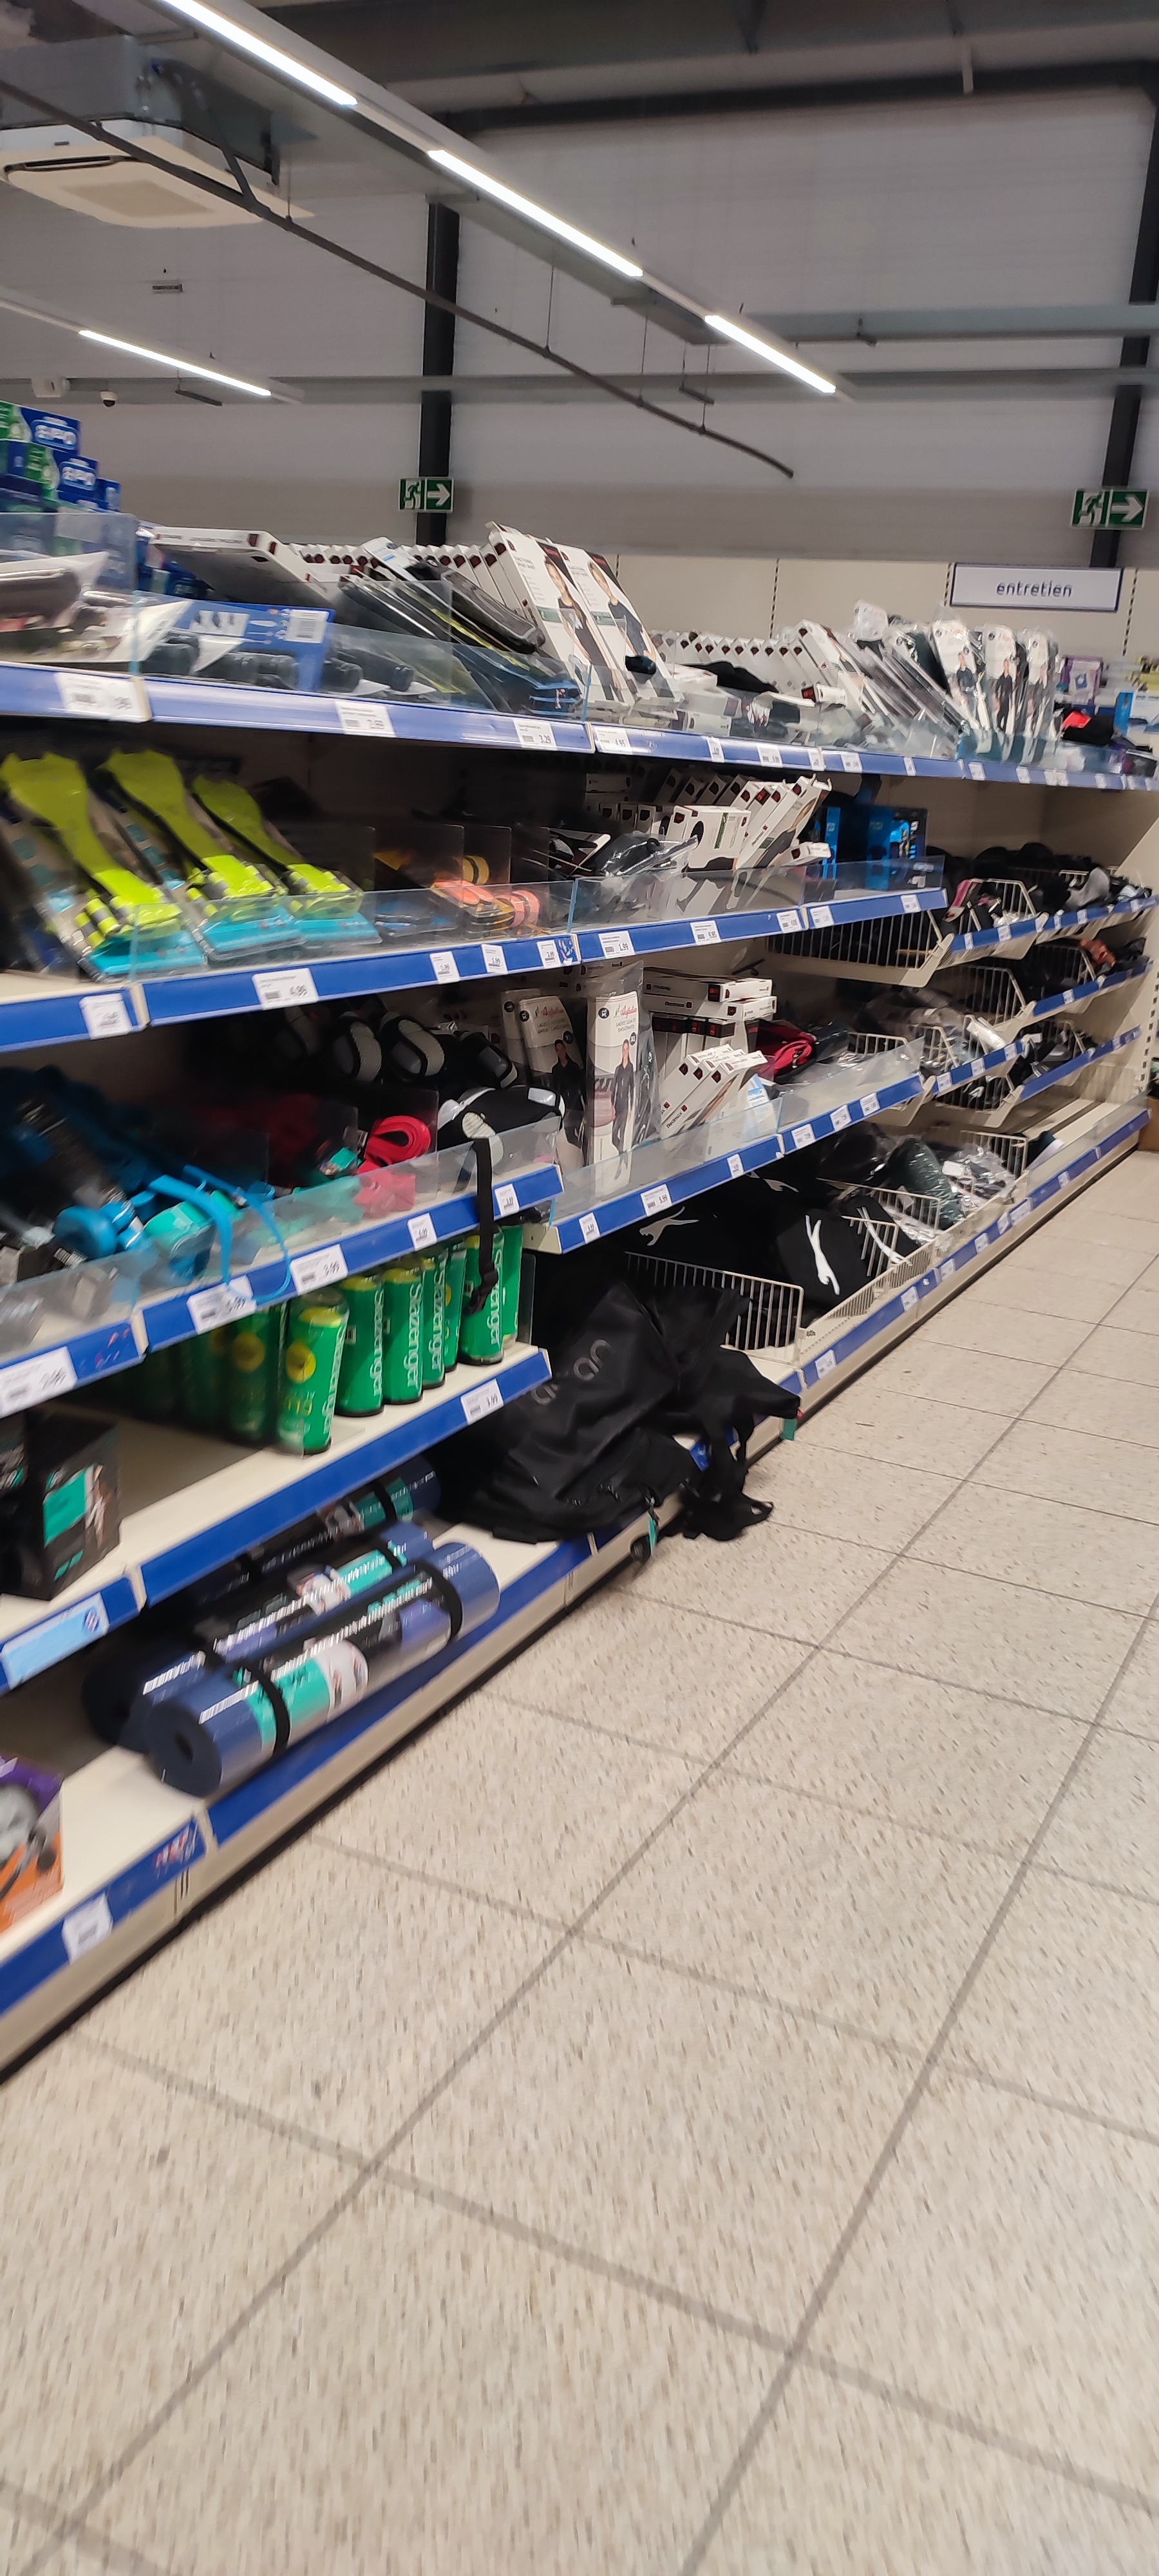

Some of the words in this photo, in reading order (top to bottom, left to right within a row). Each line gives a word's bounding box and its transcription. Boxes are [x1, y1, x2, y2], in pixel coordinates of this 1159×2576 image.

[996, 580, 1072, 598] entretien
[370, 1289, 384, 1397] Slazenger
[403, 1283, 422, 1388] Slazenger
[428, 1270, 446, 1370] Slazenger
